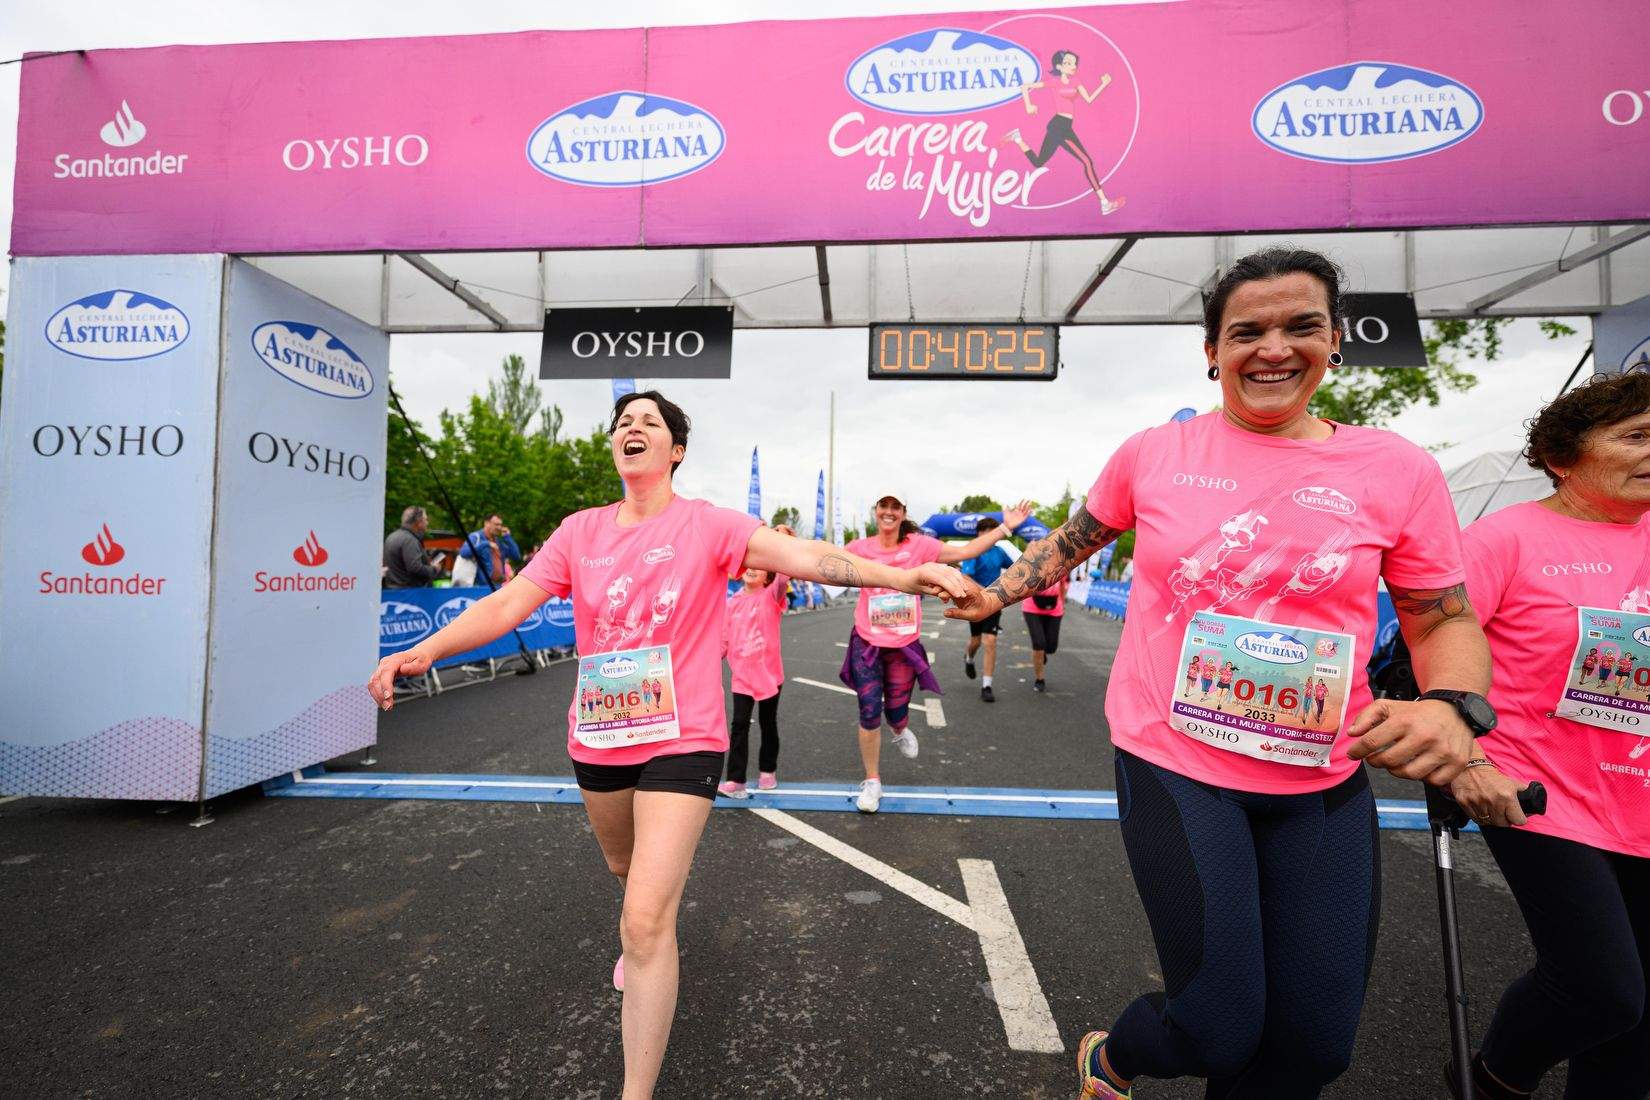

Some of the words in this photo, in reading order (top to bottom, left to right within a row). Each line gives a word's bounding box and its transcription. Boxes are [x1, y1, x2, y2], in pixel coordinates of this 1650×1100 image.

[861, 62, 1024, 95] ASTURIANA
[1304, 97, 1374, 108] CENTRAL
[1381, 92, 1457, 105] LECHERA
[572, 124, 634, 136] CENTRAL
[1270, 101, 1465, 138] ASTURIANA
[828, 111, 989, 158] Carrera
[283, 134, 429, 171] OYSHO
[542, 130, 709, 164] ASTURIANA
[53, 150, 188, 179] Santander
[866, 159, 896, 191] de
[902, 157, 924, 190] la
[919, 147, 1050, 228] Mujer
[56, 316, 179, 344] ASTURIANA
[571, 329, 705, 359] OYSHO
[879, 329, 1045, 371] 00:40:25
[263, 332, 366, 392] ASTURIANA
[33, 423, 184, 458] OYSHO
[248, 431, 371, 482] OYSHO
[1172, 472, 1238, 492] OYSHO
[1542, 562, 1612, 577] OYSHO
[40, 571, 166, 595] Santander
[254, 571, 357, 594] Santander
[1198, 623, 1225, 636] SUMA
[1591, 619, 1622, 629] SUMA
[1240, 637, 1304, 660] ASTURIANA
[603, 691, 641, 710] 016
[1233, 678, 1299, 710] 016
[1571, 691, 1610, 704] CARRERA
[1611, 698, 1624, 707] DE
[1625, 701, 1637, 709] LA
[613, 711, 631, 720] 2032
[1177, 704, 1213, 719] CARRERA
[1214, 714, 1225, 723] DE
[1226, 717, 1237, 726] LA
[1239, 719, 1267, 732] MUJER
[1244, 708, 1276, 723] 2033
[1580, 707, 1640, 726] OYSHO
[1186, 721, 1240, 744] OYSHO
[1272, 744, 1319, 758] Santander
[1600, 761, 1645, 777] CARRERA
